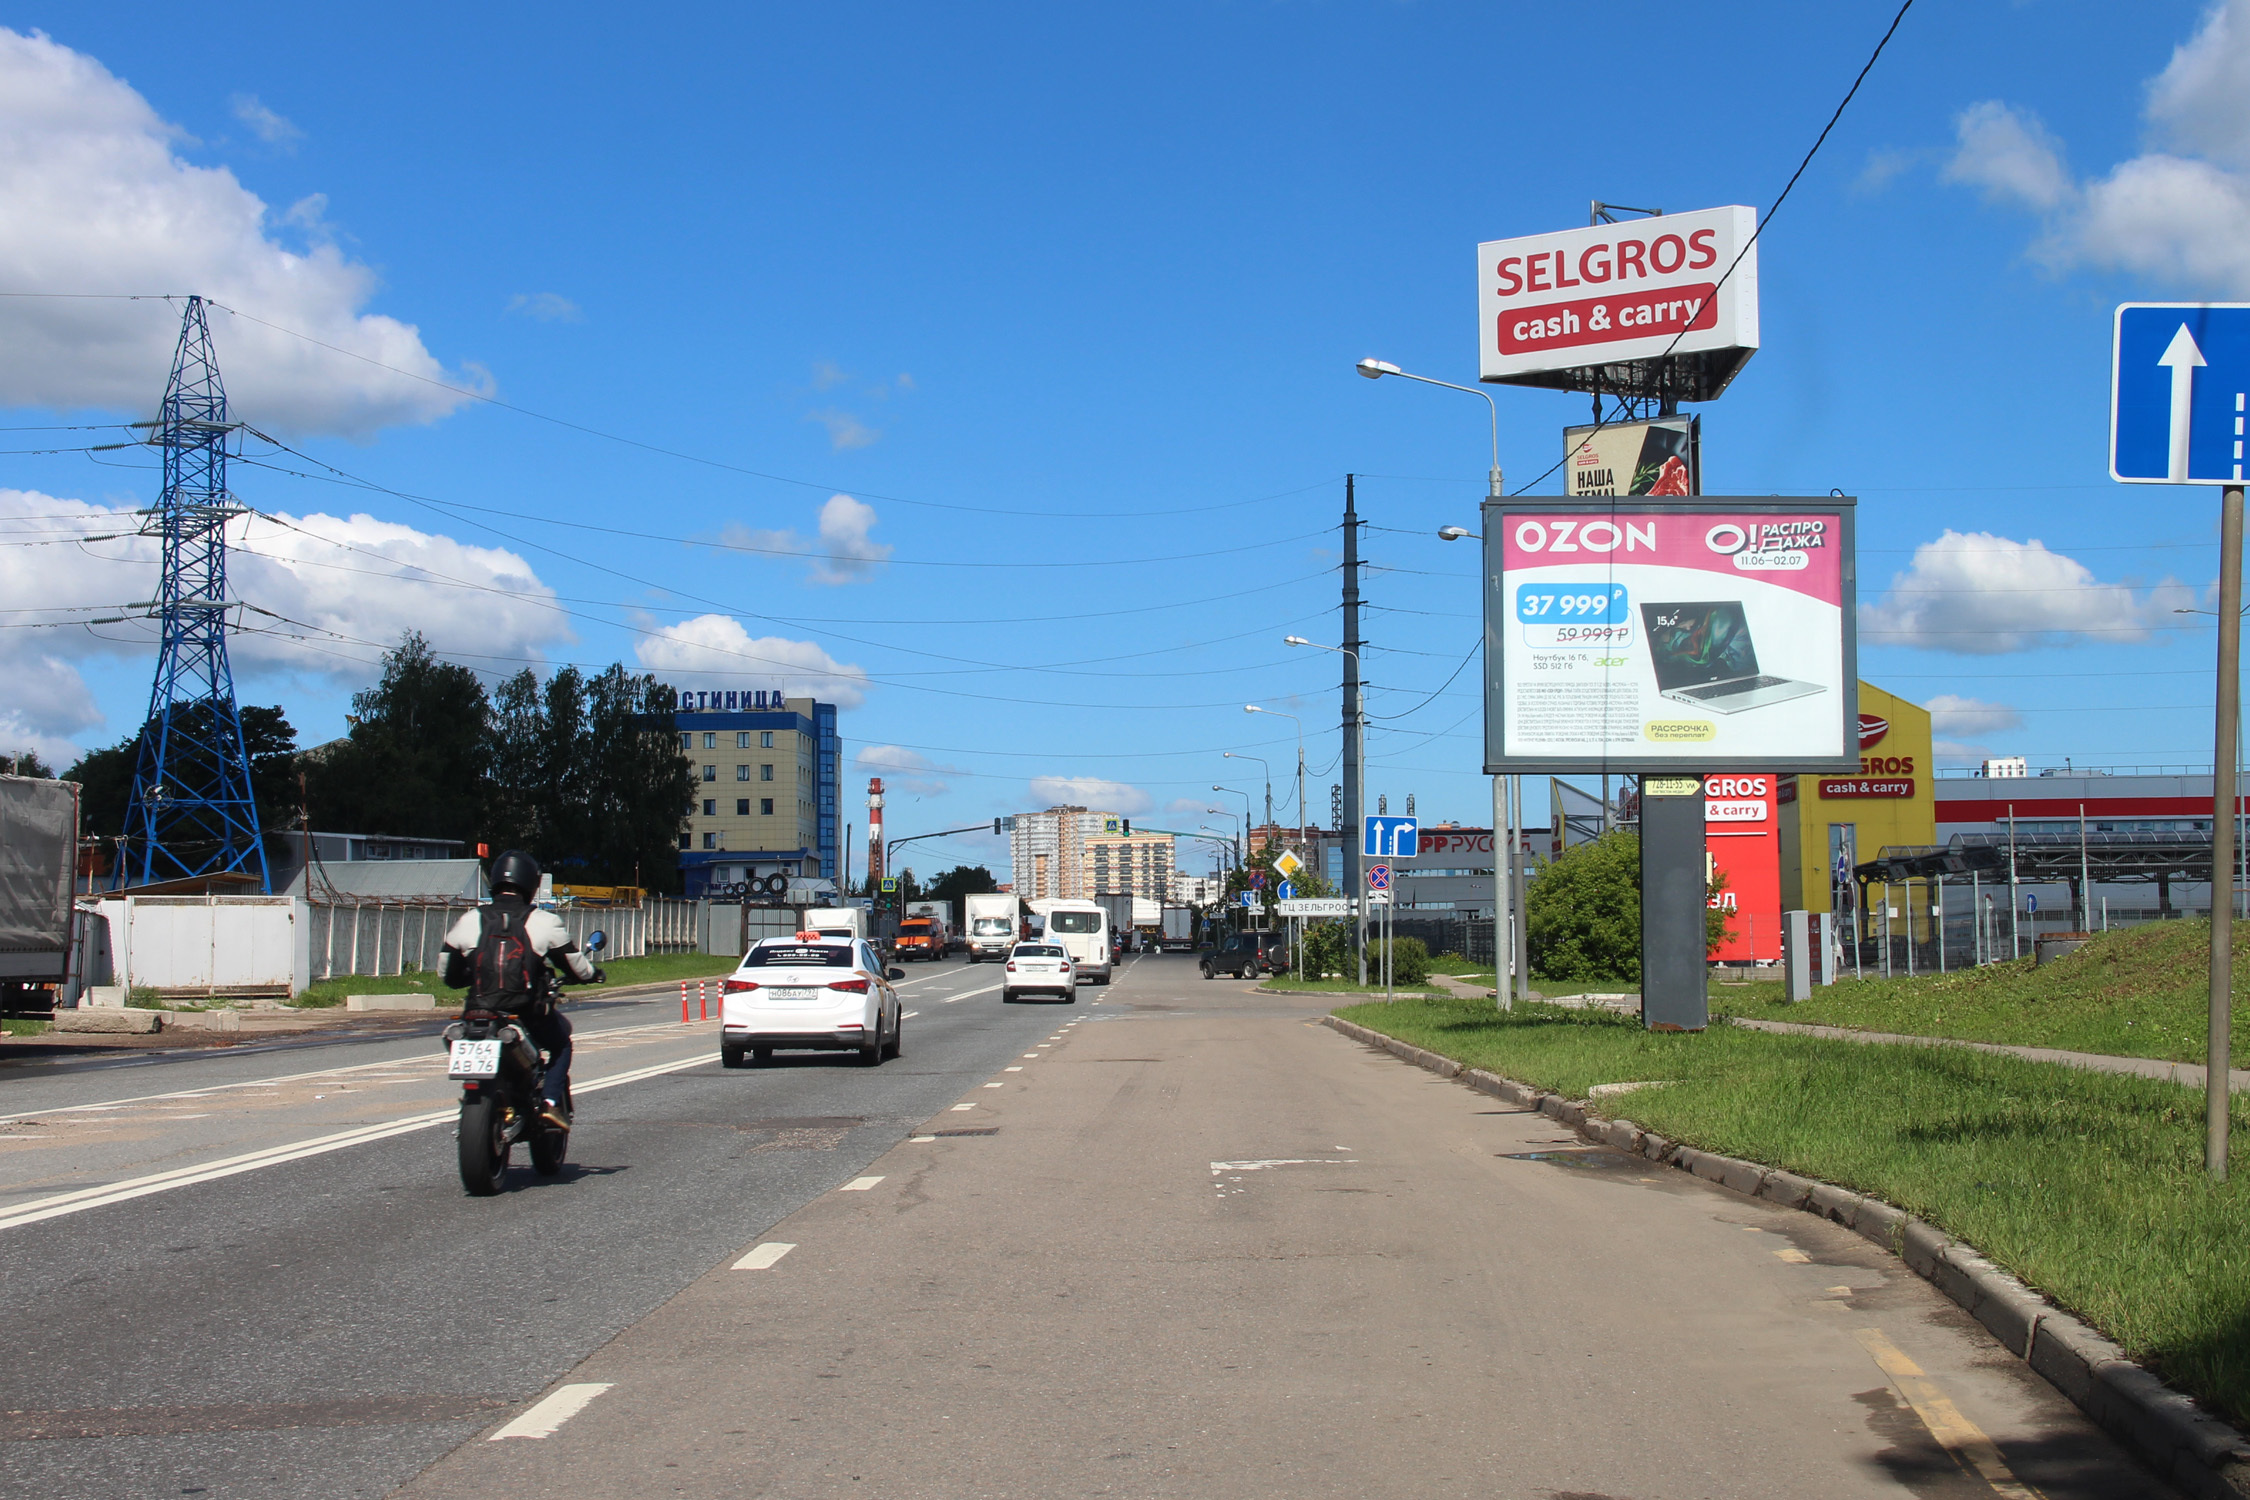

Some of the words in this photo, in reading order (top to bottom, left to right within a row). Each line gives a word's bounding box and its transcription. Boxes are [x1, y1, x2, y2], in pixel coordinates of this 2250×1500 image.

[1497, 229, 1717, 296] SELGROS
[1513, 309, 1580, 341] cash
[1588, 304, 1611, 331] &
[1618, 298, 1702, 327] carry
[1577, 468, 1614, 488] НАША
[1761, 520, 1823, 537] РАСПРО
[1515, 521, 1656, 553] OZON
[1760, 534, 1822, 552] ДАЖА
[1522, 595, 1555, 616] 37
[1559, 595, 1608, 616] 999
[1556, 627, 1577, 642] 59
[1582, 627, 1613, 642] 999
[1533, 654, 1566, 662] Ноутбук
[1564, 662, 1573, 670] Гб
[1593, 657, 1629, 667] acer
[1853, 757, 1914, 775] GROS
[1704, 778, 1767, 797] GROS
[1826, 782, 1857, 793] cash
[1859, 782, 1870, 793] &
[1872, 783, 1908, 795] carry
[1709, 804, 1720, 816] &
[1723, 806, 1760, 818] carry
[1282, 904, 1296, 912] ТЦ
[1298, 903, 1348, 912] ЗЕЛЬГРОС
[458, 1043, 492, 1055] 5764
[451, 1060, 472, 1072] АВ
[478, 1060, 493, 1072] 76
